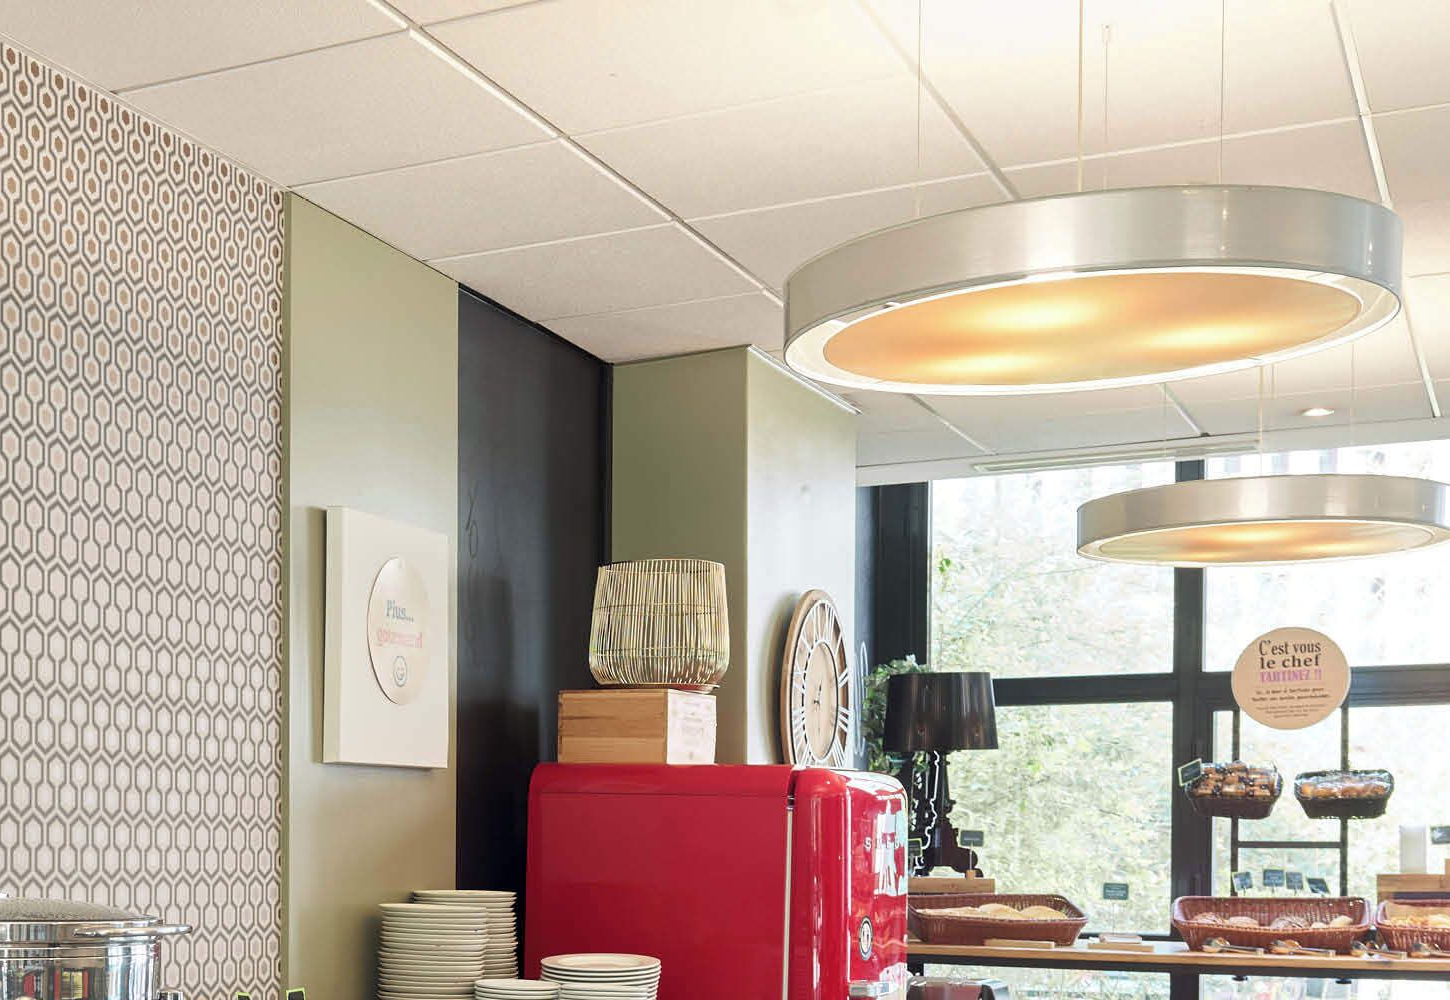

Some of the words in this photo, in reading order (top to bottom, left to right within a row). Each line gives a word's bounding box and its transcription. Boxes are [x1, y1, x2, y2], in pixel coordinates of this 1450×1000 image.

[1293, 642, 1321, 654] vous
[1260, 657, 1276, 669] le
[1282, 653, 1322, 668] chef
